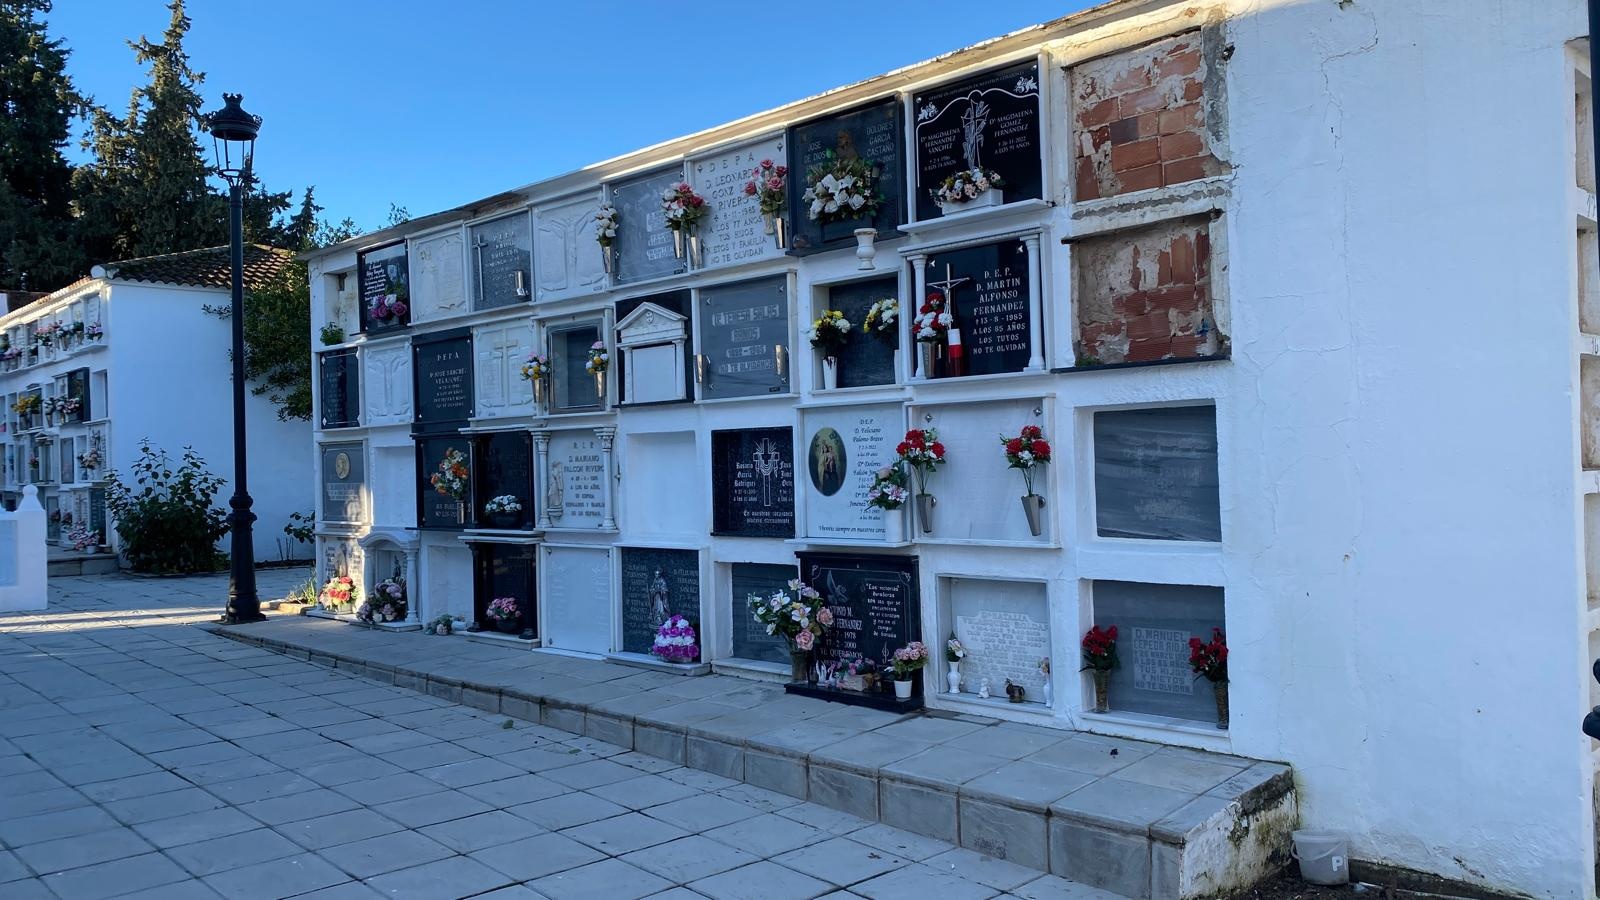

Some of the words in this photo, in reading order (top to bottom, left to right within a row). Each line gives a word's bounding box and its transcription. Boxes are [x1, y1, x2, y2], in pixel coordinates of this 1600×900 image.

[998, 109, 1033, 122] MAGDALENA
[866, 121, 894, 134] DOLORES
[928, 128, 960, 141] MAGDALENA
[716, 168, 752, 186] LEONARD
[716, 224, 730, 232] LOS
[718, 232, 730, 240] TUS
[734, 228, 754, 238] HIJOS
[706, 242, 730, 254] NIETOS
[711, 256, 720, 264] NO
[722, 254, 732, 262] TE
[734, 248, 764, 260] OLVIDAN
[986, 277, 1020, 290] MARTIN
[980, 290, 1018, 304] ALFONSO
[974, 301, 1024, 316] FERNANDEZ
[978, 326, 992, 334] LOS
[1007, 321, 1026, 332] AÑOS
[997, 334, 1020, 342] TUYOS
[996, 342, 1026, 352] OLVIDAN
[836, 618, 862, 630] FERNANDEZ
[1146, 630, 1186, 642] MANUEL
